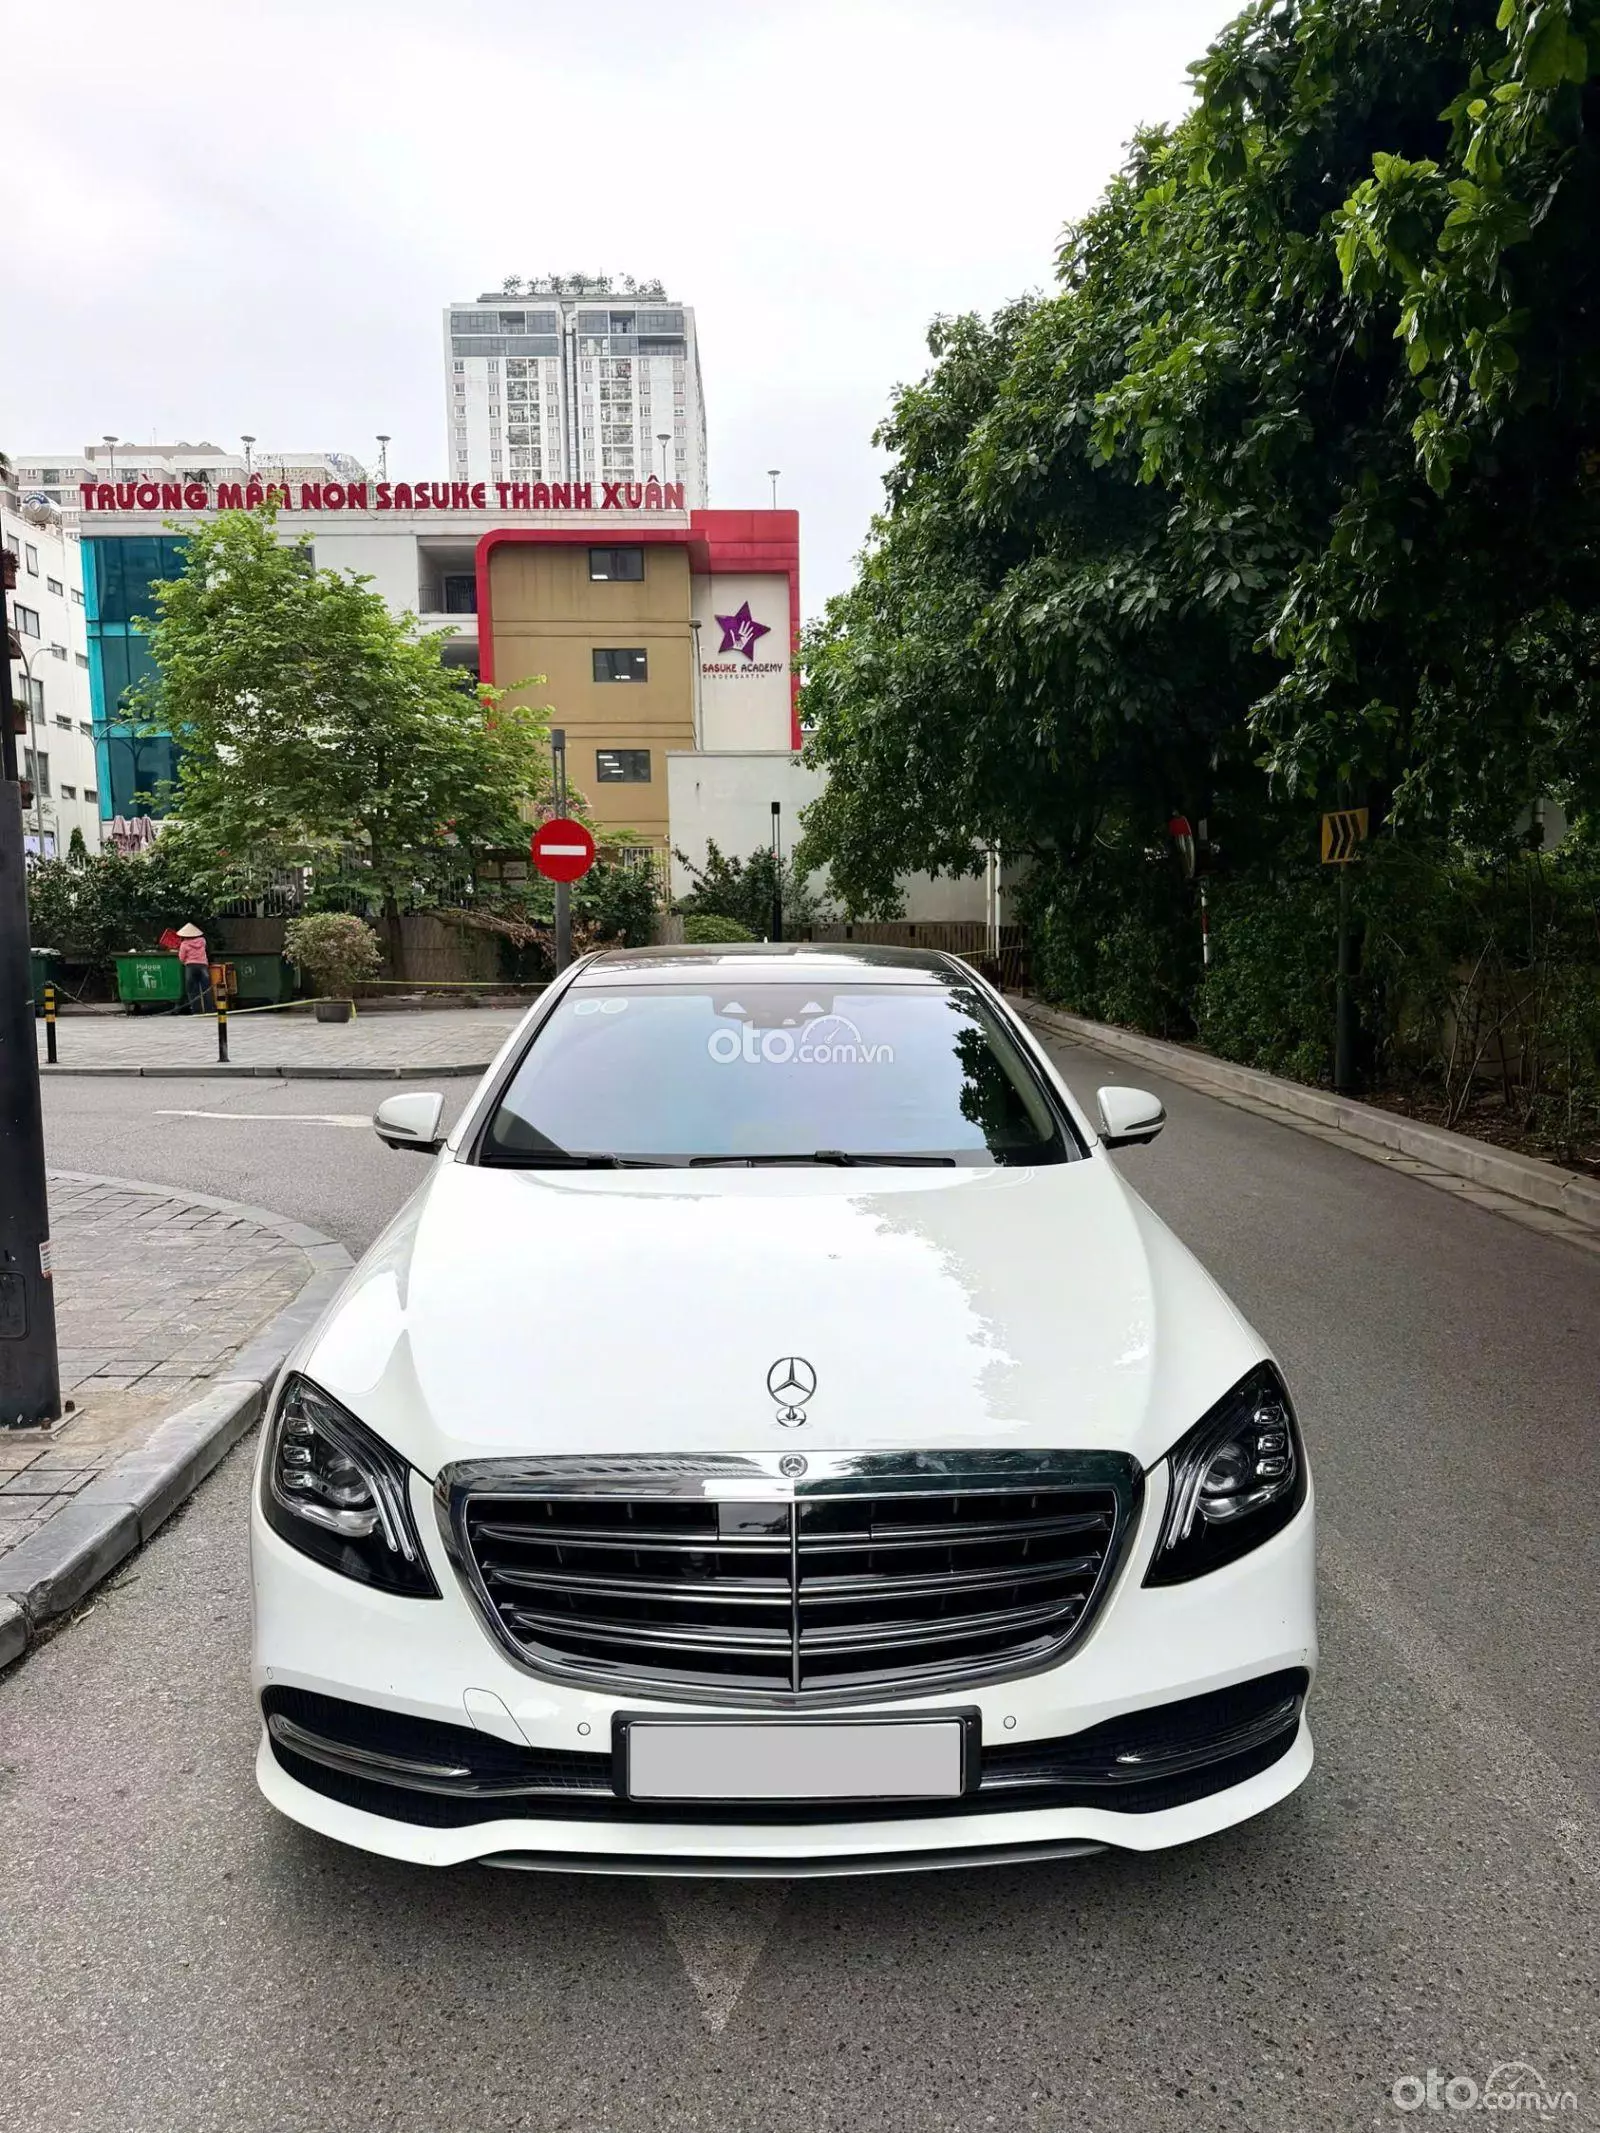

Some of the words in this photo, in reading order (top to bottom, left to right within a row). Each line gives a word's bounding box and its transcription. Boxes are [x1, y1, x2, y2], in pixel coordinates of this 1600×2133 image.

[80, 473, 207, 510] TRƯỜNG
[301, 482, 367, 510] NON
[376, 482, 486, 510] SASUKE
[495, 482, 592, 510] THANH
[601, 474, 685, 510] XUÂN
[702, 663, 737, 673] SASUKE
[741, 662, 783, 673] ACADEMY
